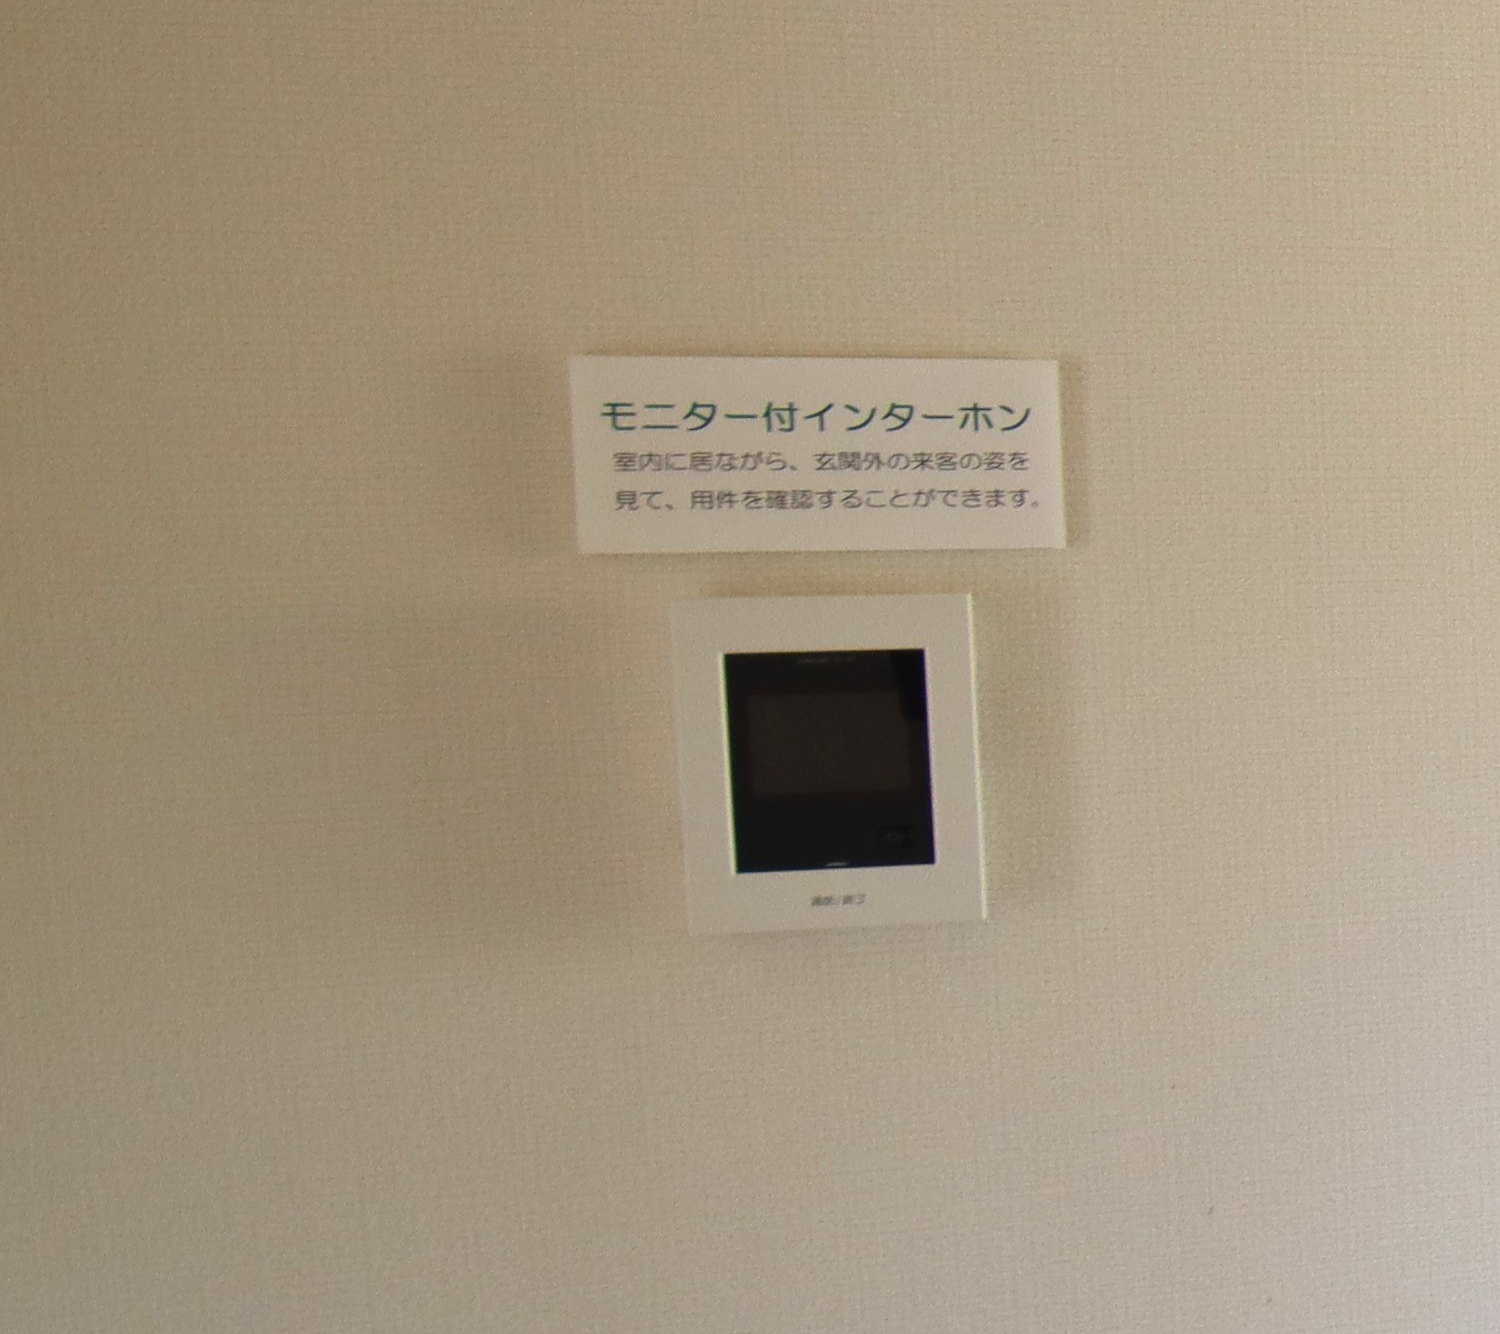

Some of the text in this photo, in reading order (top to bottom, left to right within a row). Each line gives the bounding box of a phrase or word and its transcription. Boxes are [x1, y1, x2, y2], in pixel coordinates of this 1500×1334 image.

[600, 400, 1032, 434] モニター付インターホン
[612, 450, 1031, 473] 室内に居ながら、玄関外の来客の姿を
[614, 487, 1041, 513] 見て、用件を確認することができます。
